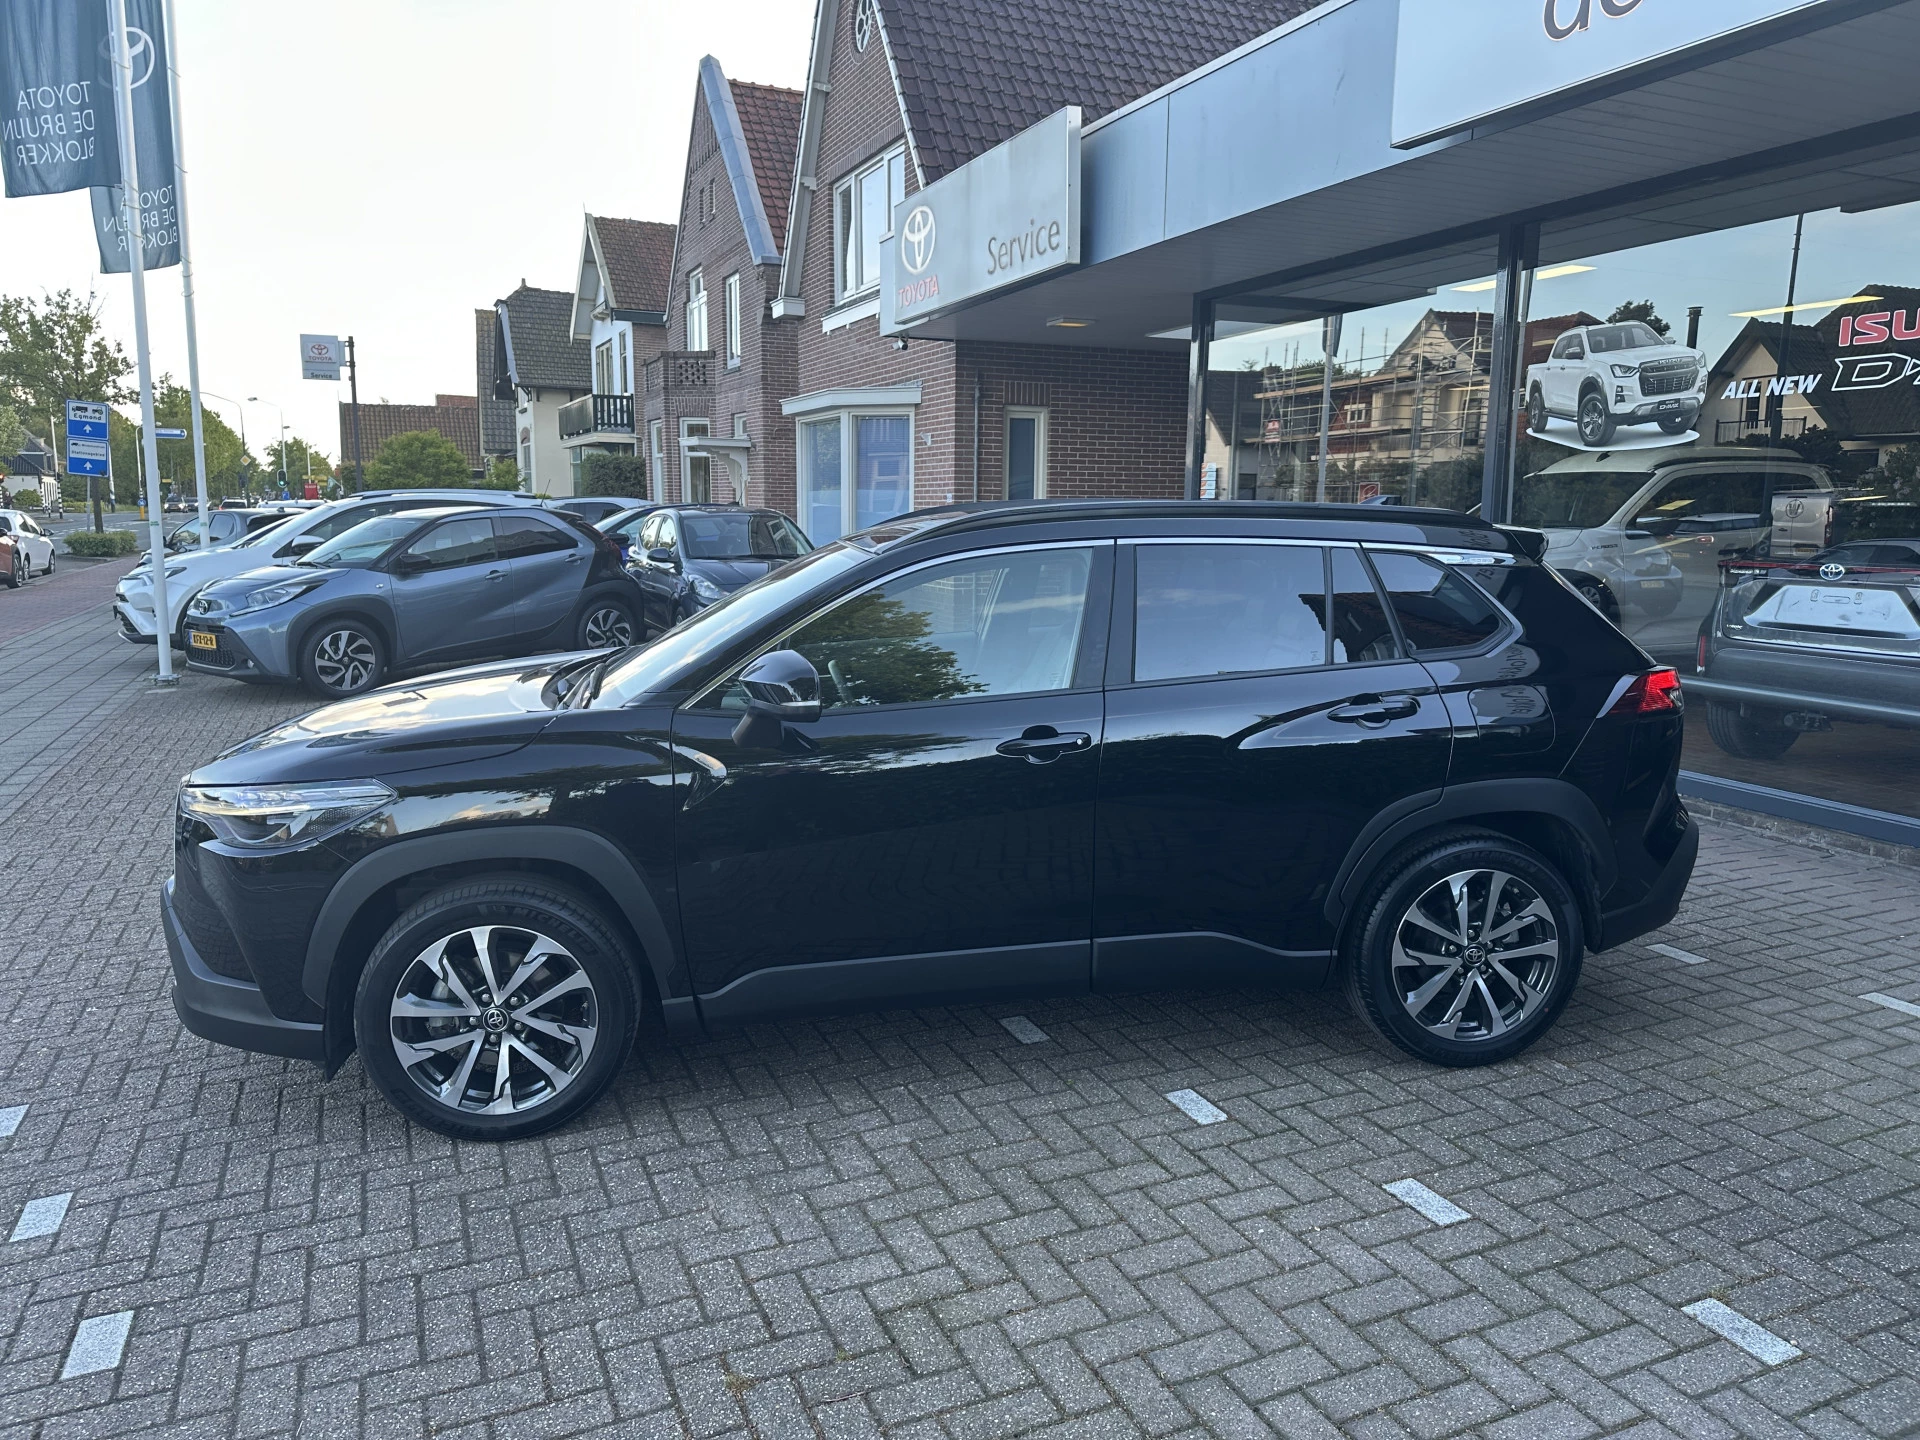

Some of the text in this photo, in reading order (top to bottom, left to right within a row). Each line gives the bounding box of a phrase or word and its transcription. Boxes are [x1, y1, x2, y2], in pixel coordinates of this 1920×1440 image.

[986, 218, 1061, 276] Service
[898, 274, 940, 309] TOYOTA
[1720, 373, 1823, 400] ALL NEW
[73, 412, 102, 421] Egmond
